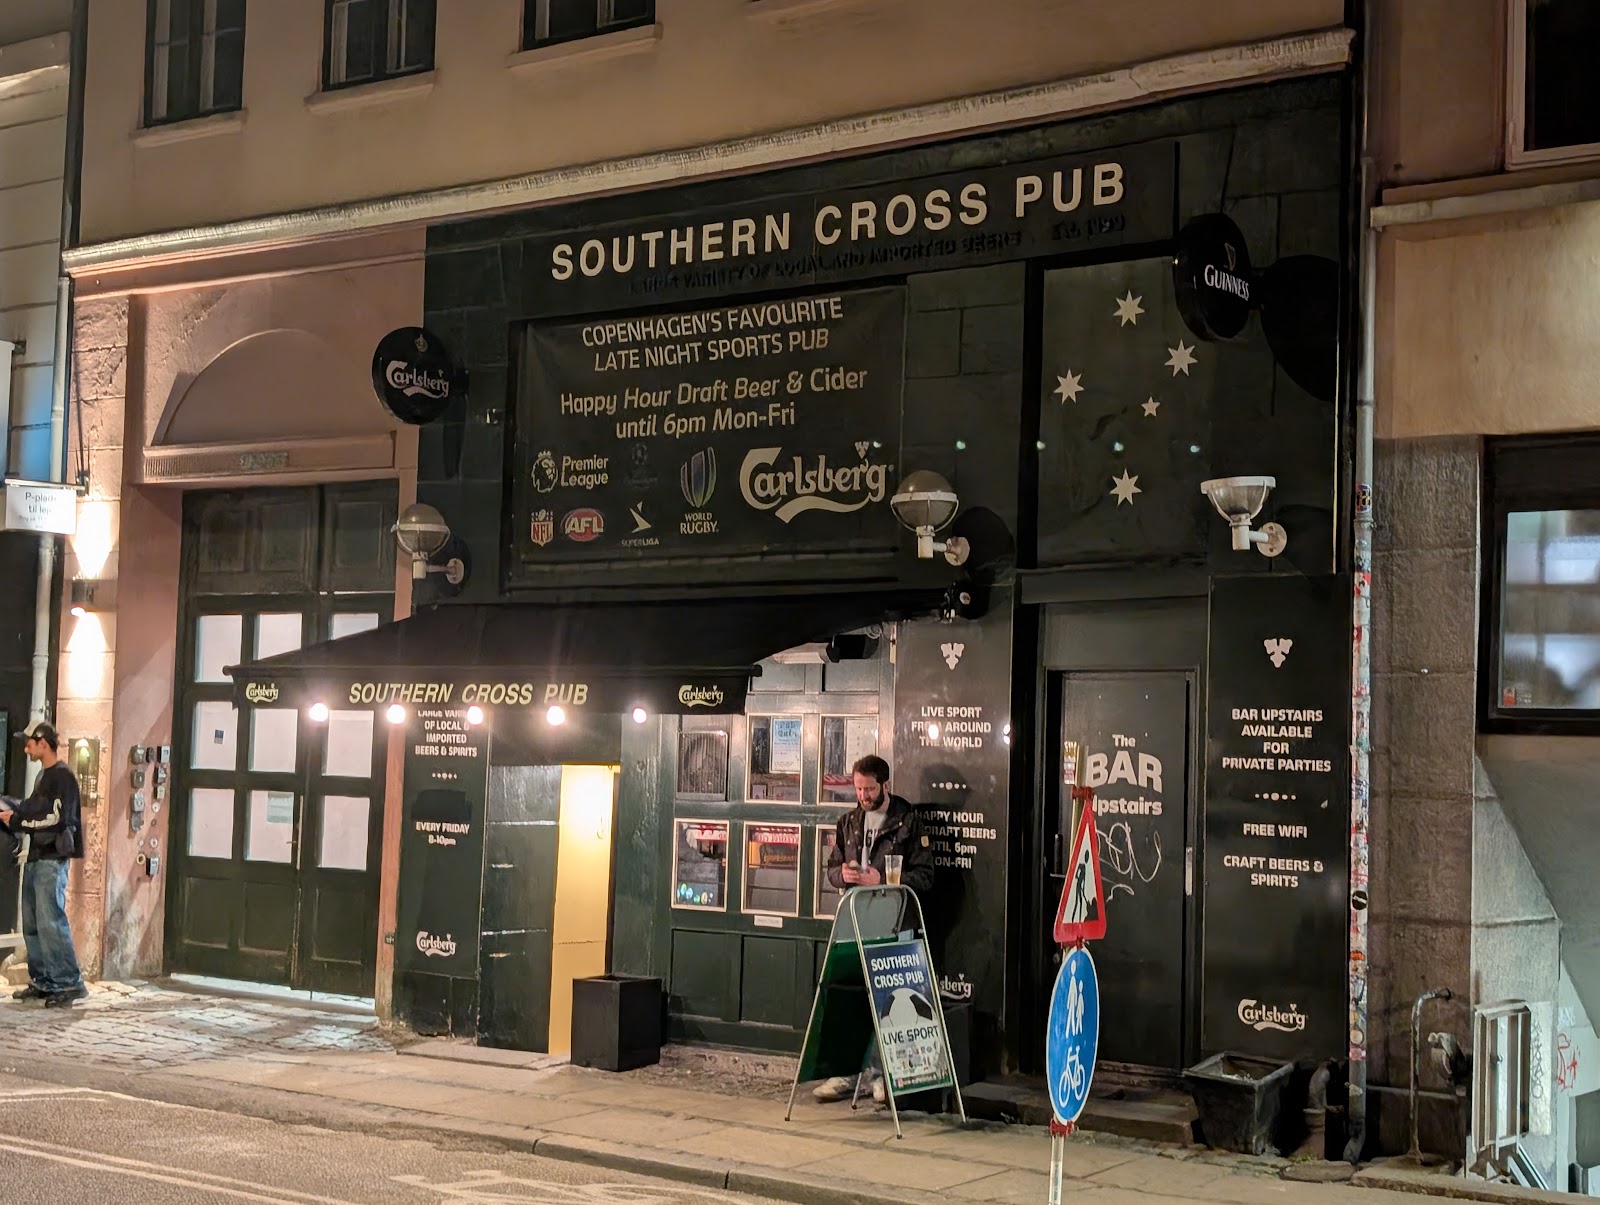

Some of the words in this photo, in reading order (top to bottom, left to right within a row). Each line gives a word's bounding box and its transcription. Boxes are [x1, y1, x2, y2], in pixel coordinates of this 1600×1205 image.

[552, 212, 791, 280] SOUTHERN
[815, 183, 988, 246] CROSS
[1015, 162, 1124, 218] PUB
[1204, 264, 1250, 301] GUINNESS
[582, 312, 722, 347] COPENHAGEN'S
[728, 297, 843, 330] FAVOURITE
[594, 350, 640, 372] LATE
[645, 342, 702, 367] NIGHT
[708, 333, 783, 361] SPORTS
[789, 328, 829, 352] PUB
[386, 360, 449, 398] Carlsberg
[560, 393, 617, 418] Happy
[623, 387, 672, 410] Hour
[677, 379, 728, 405] Draft
[734, 377, 780, 398] Beer
[786, 370, 803, 394] &
[810, 367, 868, 392] Cider
[616, 414, 657, 439] until
[663, 413, 706, 439] 6pm
[712, 402, 795, 431] Mon-Fri
[562, 454, 609, 471] Premier
[560, 472, 609, 490] League
[740, 446, 887, 523] Carlsberg
[565, 517, 604, 534] AFL
[684, 512, 712, 522] WORLD
[531, 523, 553, 543] NFL
[680, 521, 717, 535] RUGBY
[245, 682, 279, 703] Carlsberg
[349, 682, 453, 704] SOUTHERN
[461, 683, 534, 705] CROSS
[543, 683, 589, 705] PUB
[678, 684, 724, 708] Carlsberg
[921, 706, 944, 717] LIVE
[947, 707, 982, 718] SPORT
[1232, 708, 1258, 721] BAR
[1261, 709, 1323, 722] UPSTAIRS
[424, 720, 435, 730] OF
[436, 720, 462, 731] LOCAL
[945, 721, 992, 733] AROUND
[1241, 725, 1313, 739] AVAILABLE
[426, 733, 468, 744] IMPORTED
[943, 736, 983, 748] WORLD
[1112, 734, 1136, 748] The
[415, 744, 440, 756] BEERS
[448, 746, 477, 758] SPIRITS
[1263, 742, 1290, 755] FOR
[1086, 750, 1163, 793] BAR
[1222, 757, 1274, 771] PRIVATE
[1277, 759, 1332, 773] PARTIES
[953, 812, 984, 824] HOUR
[416, 822, 441, 832] EVERY
[442, 822, 470, 835] FRIDAY
[962, 827, 997, 840] BEERS
[1243, 823, 1275, 837] FREE
[1278, 824, 1308, 838] WIFI
[955, 842, 977, 856] 6pm
[935, 857, 972, 870] ON-FRI
[1223, 855, 1266, 870] CRAFT
[1269, 857, 1310, 872] BEERS
[1313, 861, 1324, 873] &
[1250, 873, 1299, 888] SPIRITS
[416, 931, 457, 957] Carlsberg
[870, 953, 920, 972] SOUTHERN
[874, 974, 905, 989] CROSS
[906, 970, 924, 986] PUB
[1238, 998, 1306, 1032] Carlsberg
[882, 1030, 904, 1046] LIVE
[906, 1025, 939, 1042] SPORT
